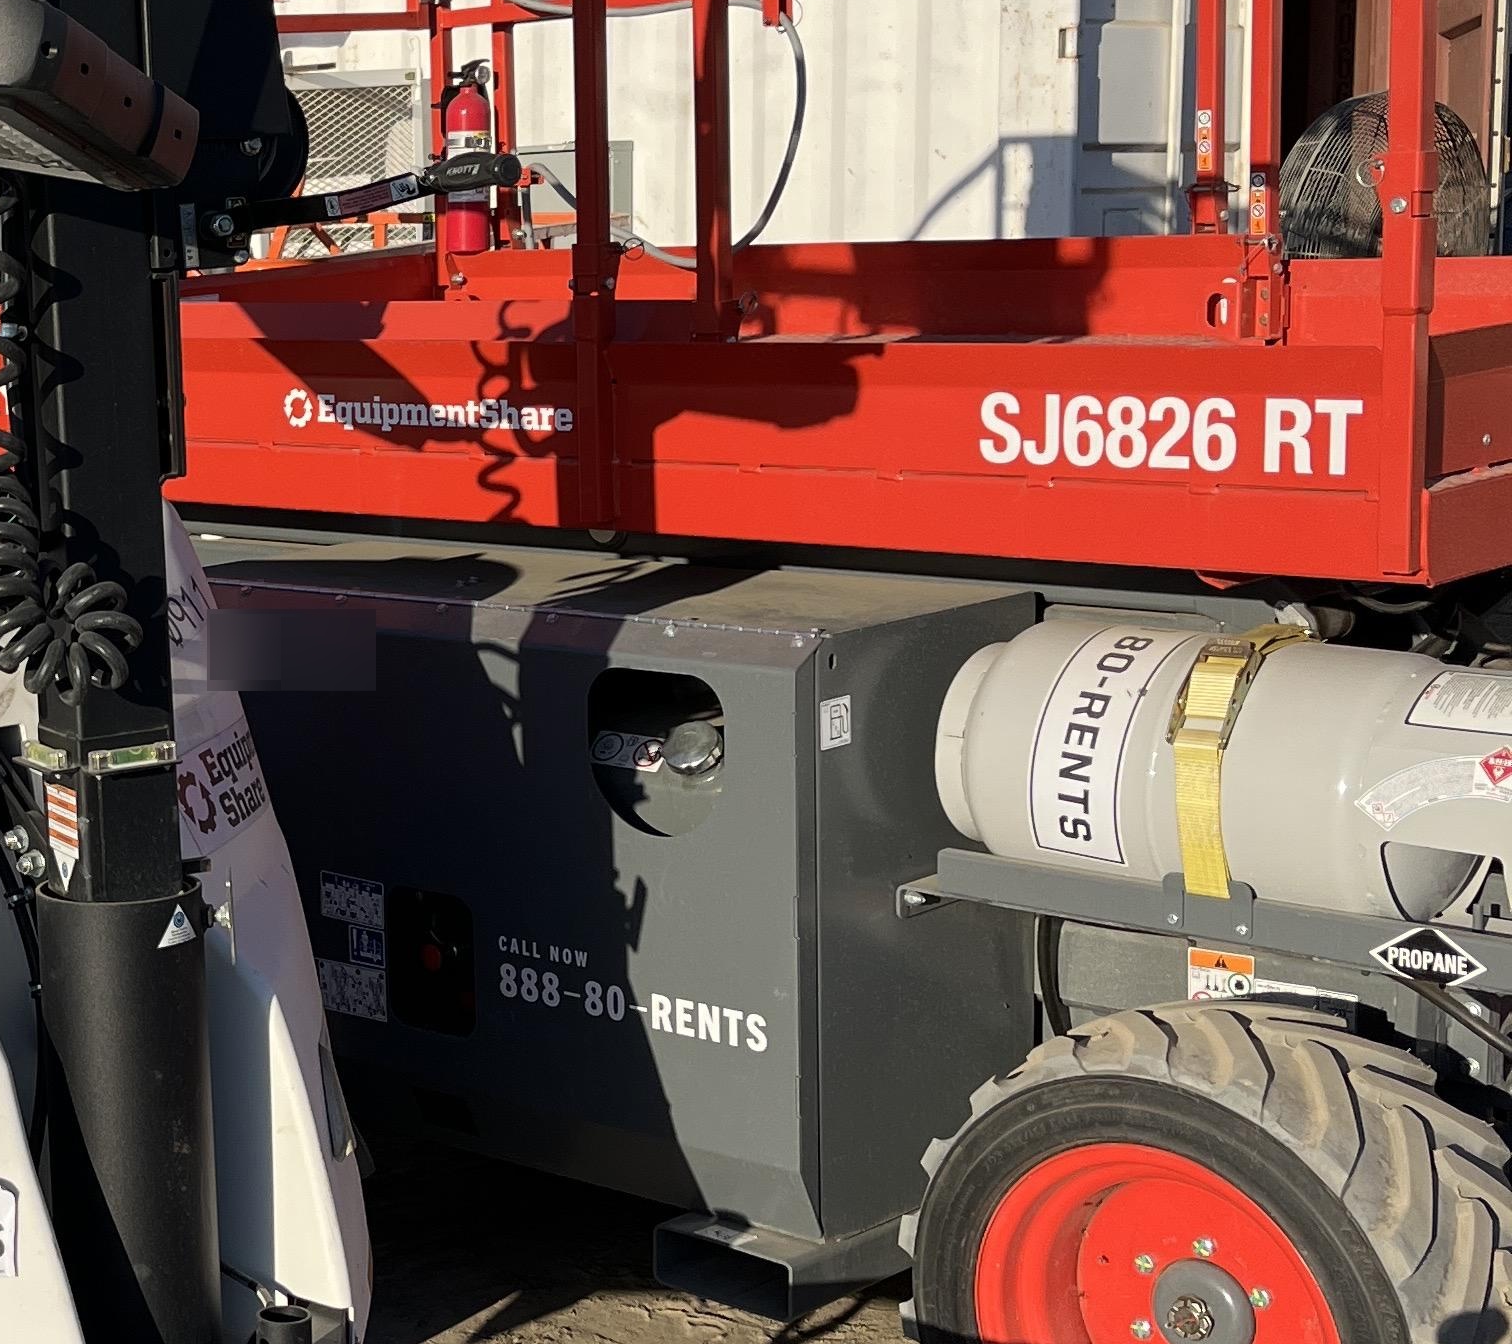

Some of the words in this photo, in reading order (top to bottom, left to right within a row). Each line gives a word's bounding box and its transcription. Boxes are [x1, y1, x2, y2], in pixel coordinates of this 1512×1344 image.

[317, 394, 573, 431] EquipmentShare
[979, 391, 1237, 472] SJ6826
[1264, 397, 1364, 475] RT
[219, 776, 266, 828] Share
[498, 935, 541, 959] CALL
[549, 945, 588, 968] NOW
[1388, 946, 1468, 976] PROPANE
[499, 963, 768, 1053] 888-80-RENTS
